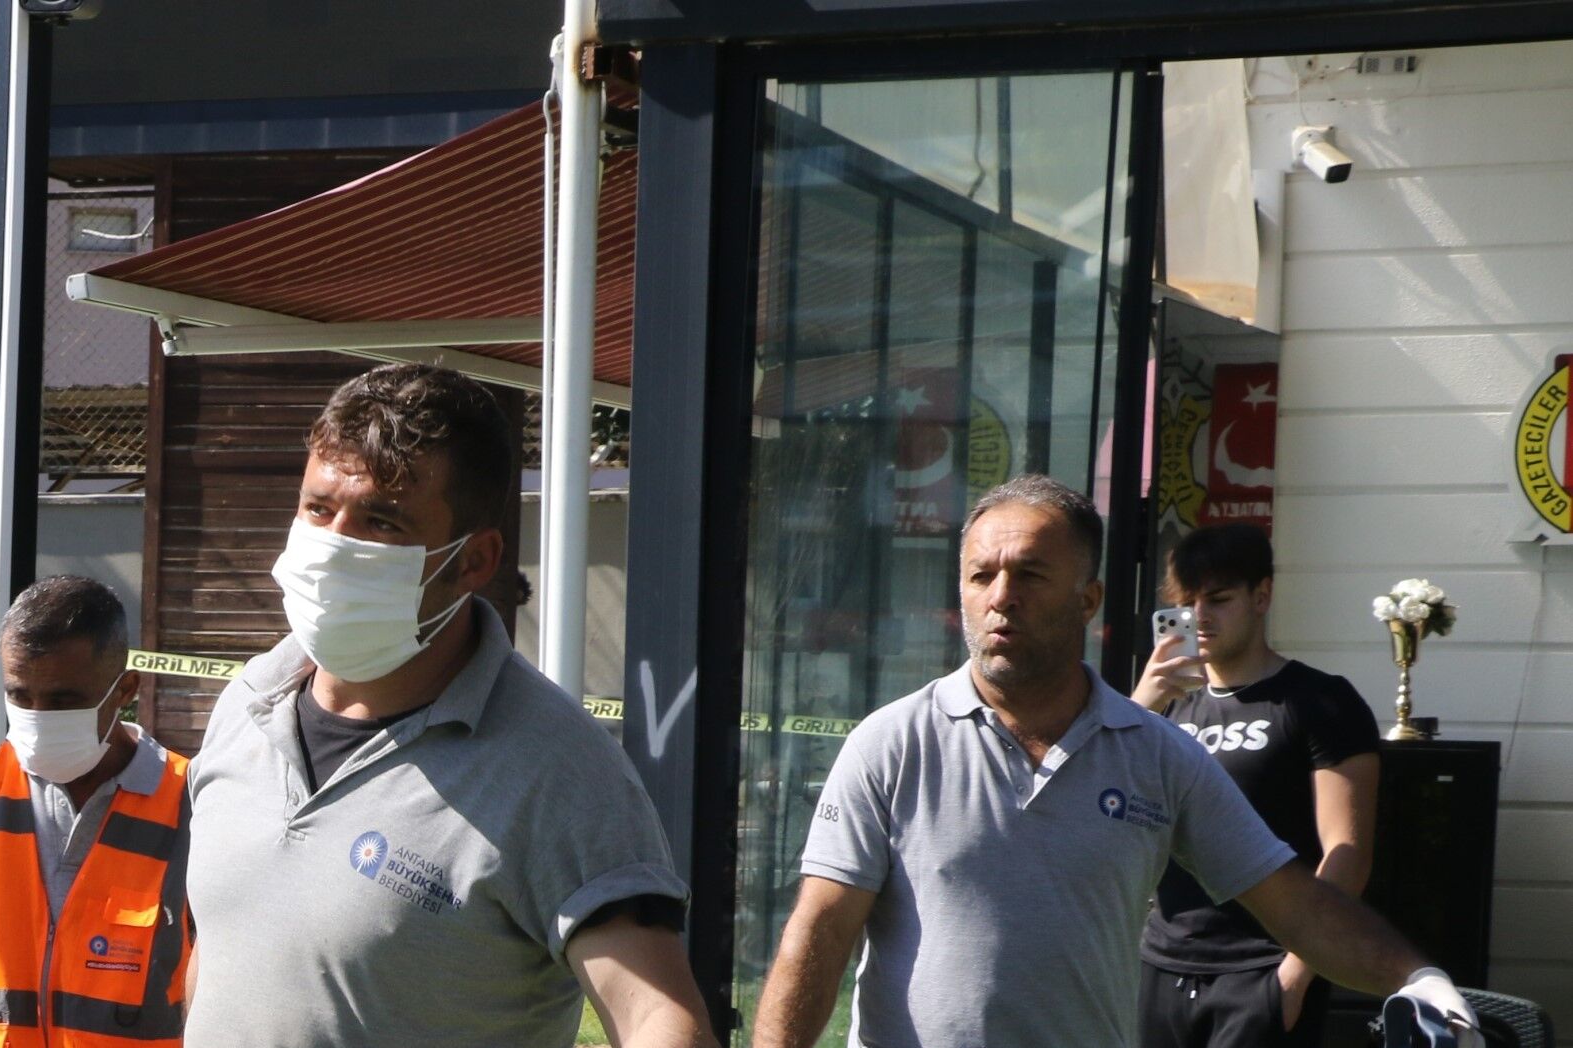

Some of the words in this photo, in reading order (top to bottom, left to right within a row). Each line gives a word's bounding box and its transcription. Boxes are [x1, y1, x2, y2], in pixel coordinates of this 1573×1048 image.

[817, 802, 840, 823] 188
[393, 846, 445, 881] ANTALYA
[378, 874, 443, 915] BELEDİYESİ
